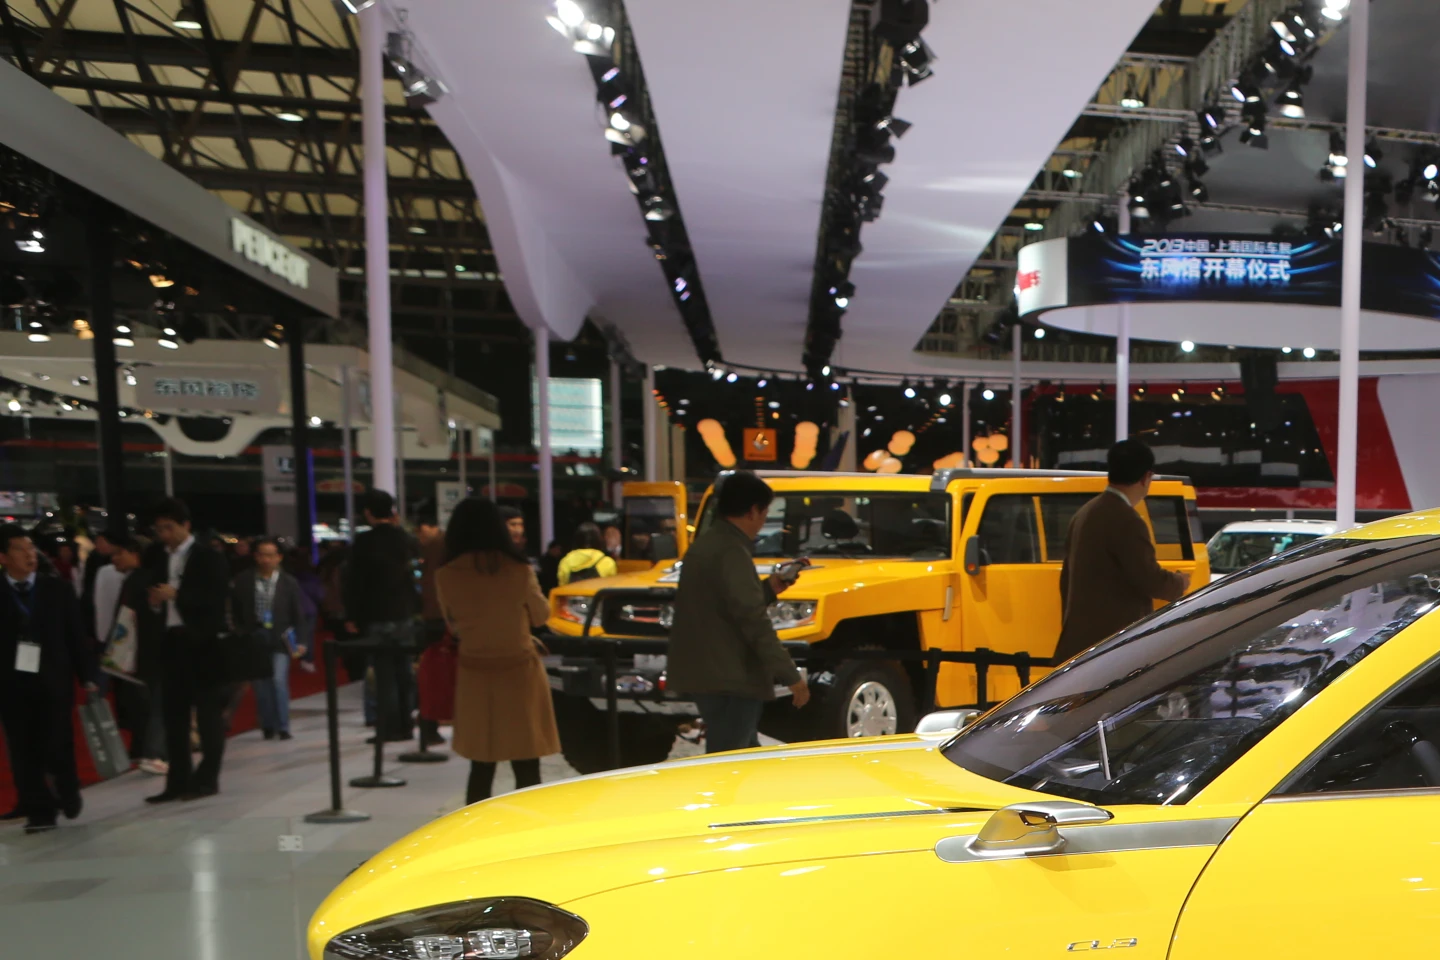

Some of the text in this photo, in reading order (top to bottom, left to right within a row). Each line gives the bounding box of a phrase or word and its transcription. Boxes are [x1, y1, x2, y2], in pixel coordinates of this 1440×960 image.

[1140, 257, 1291, 281] 东风馆开幕仪式
